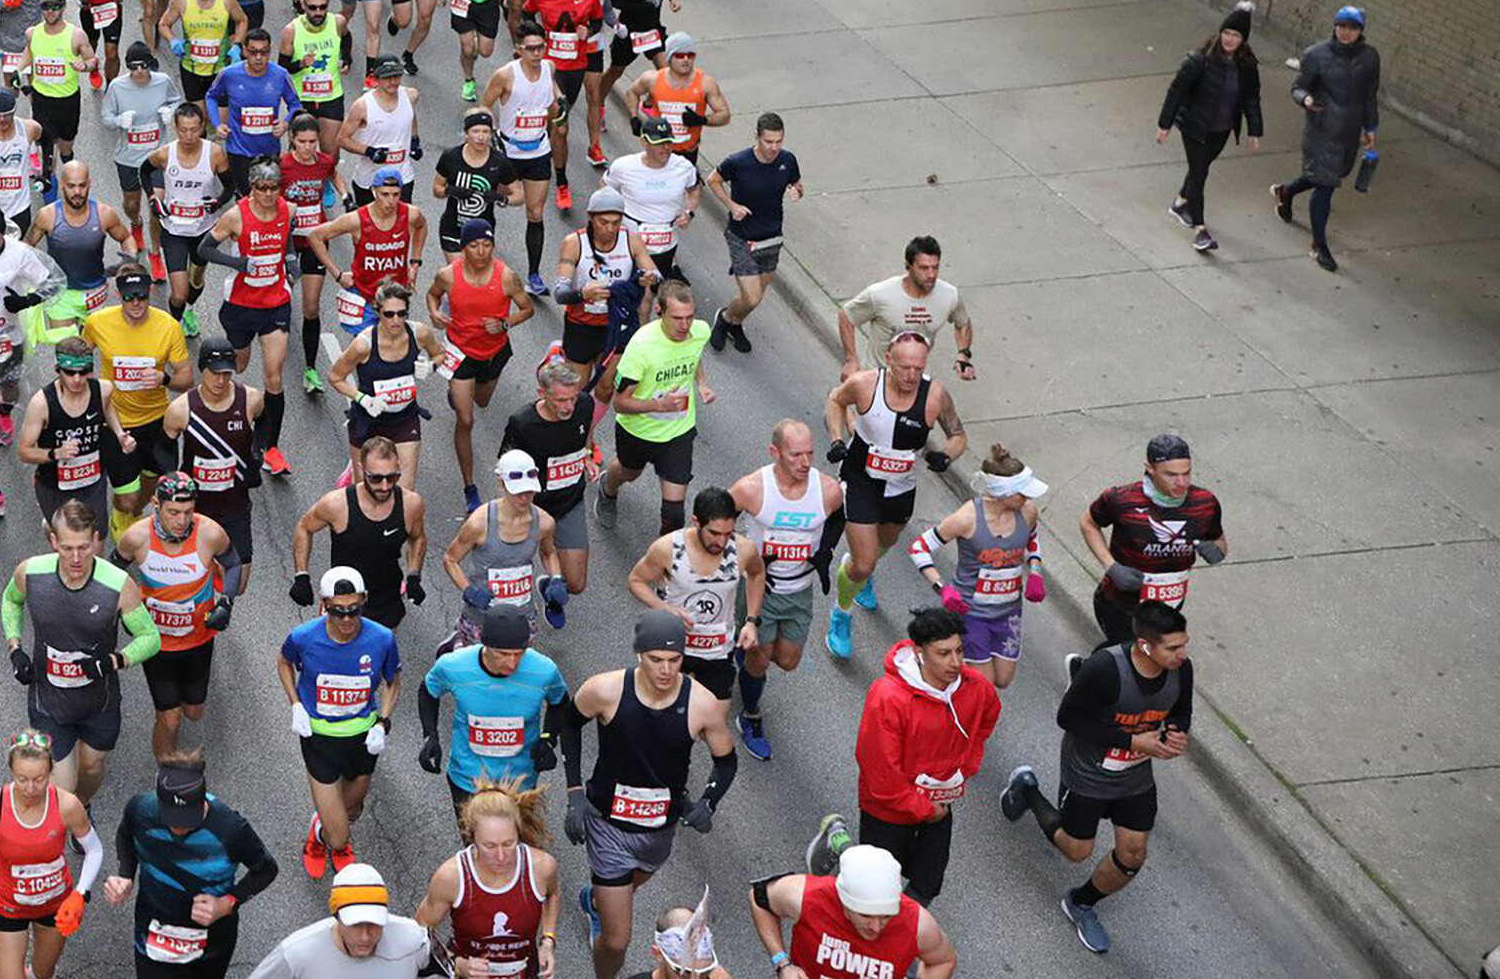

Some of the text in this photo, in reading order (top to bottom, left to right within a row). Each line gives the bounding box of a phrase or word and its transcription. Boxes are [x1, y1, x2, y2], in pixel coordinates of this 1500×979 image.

[304, 39, 334, 52] RUN LIKE
[364, 255, 404, 270] RYAN
[116, 369, 123, 379] B
[56, 424, 99, 437] GOOSE
[227, 421, 243, 431] CHI
[56, 435, 99, 446] IAND
[872, 457, 908, 471] B 5323
[64, 470, 70, 479] B
[199, 470, 205, 479] B
[549, 468, 556, 479] B
[766, 545, 807, 559] B 11314
[1143, 543, 1195, 553] ATLANTA
[492, 584, 501, 595] B
[983, 581, 990, 592] B
[1148, 588, 1155, 599] B
[160, 612, 192, 625] 17379
[52, 663, 82, 674] B 921
[320, 689, 366, 704] B 11374
[476, 732, 517, 742] B 3202
[615, 800, 665, 815] B 14249
[17, 879, 26, 893] C
[816, 945, 895, 979] POWER
